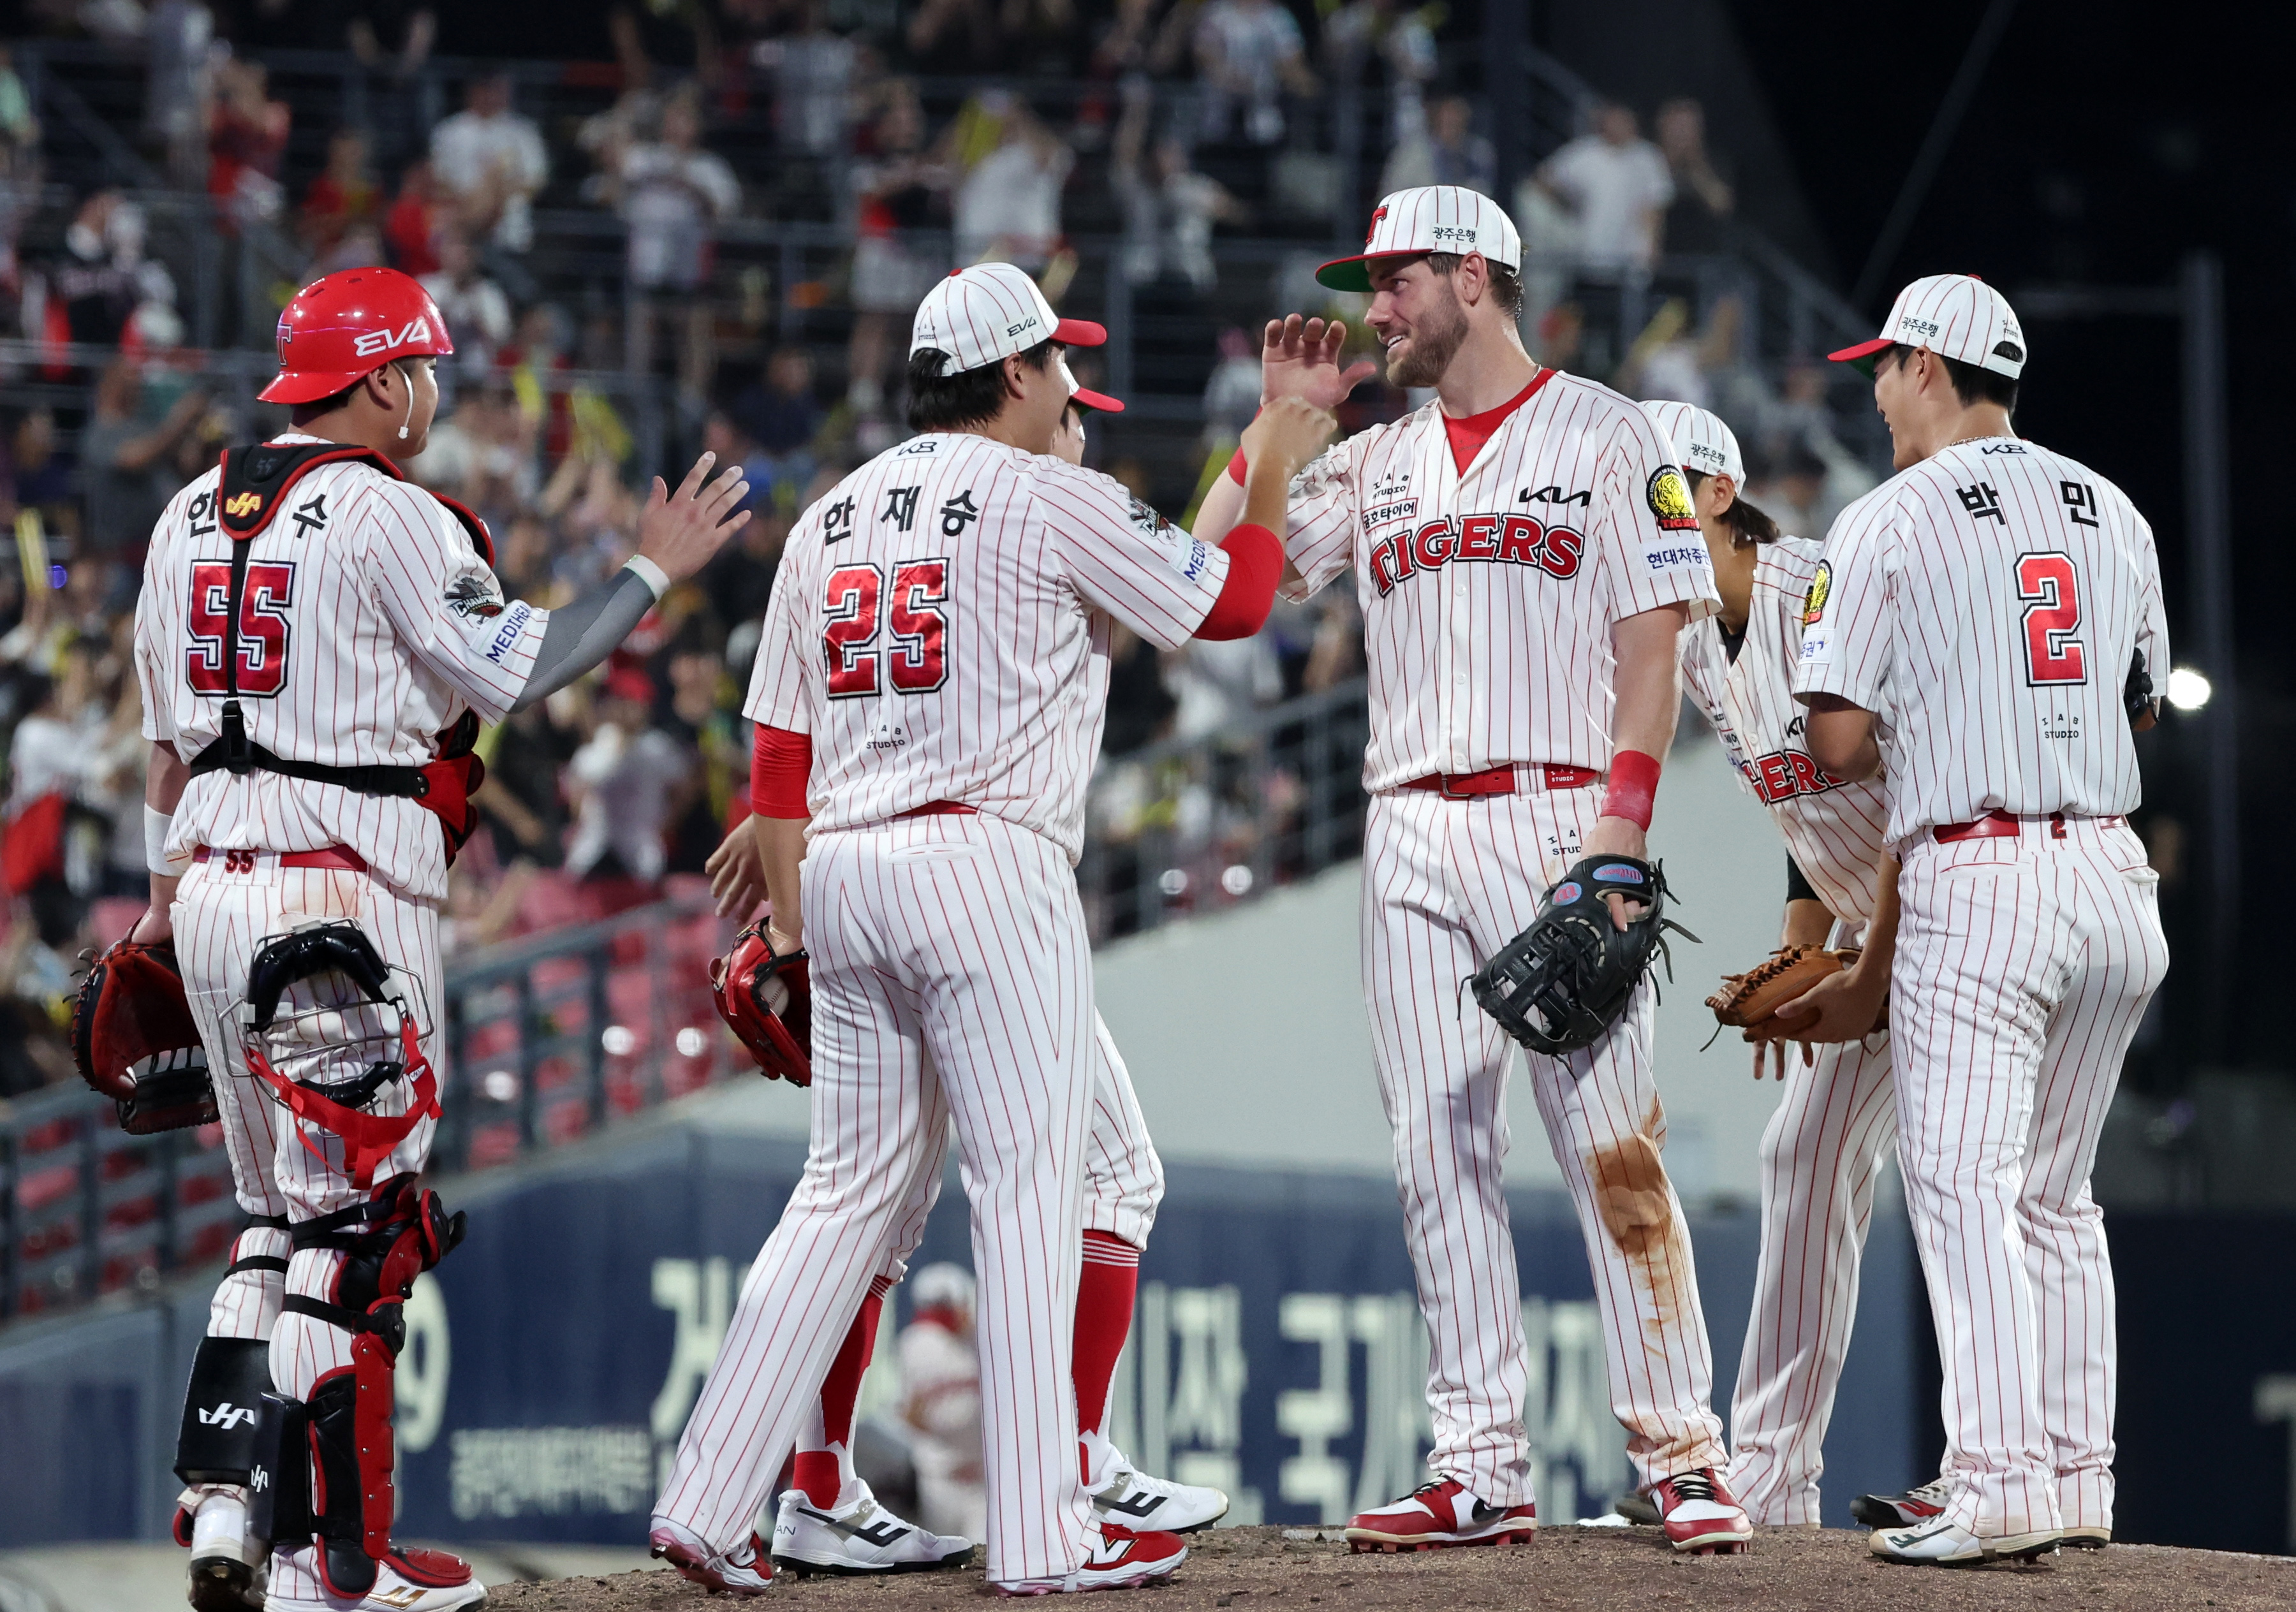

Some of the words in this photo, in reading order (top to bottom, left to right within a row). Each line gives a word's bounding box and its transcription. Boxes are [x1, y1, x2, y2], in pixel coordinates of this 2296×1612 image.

[1432, 226, 1476, 243] 광주은행
[1902, 316, 1939, 337] 광주은행
[1690, 443, 1726, 467] 광주은행
[1372, 485, 1407, 499] STUDIO
[1518, 485, 1591, 507] KIA
[188, 487, 328, 539] 한수
[1363, 501, 1415, 529] 금호타이어
[1369, 513, 1586, 598] TIGERS
[186, 559, 297, 698] 55
[821, 557, 950, 701] 25
[2013, 550, 2088, 687] 2
[866, 739, 906, 749] STUDIO
[2044, 730, 2079, 739] STUDIO
[2049, 811, 2068, 840] 2
[224, 849, 256, 875] 55
[1552, 846, 1582, 856] STUD
